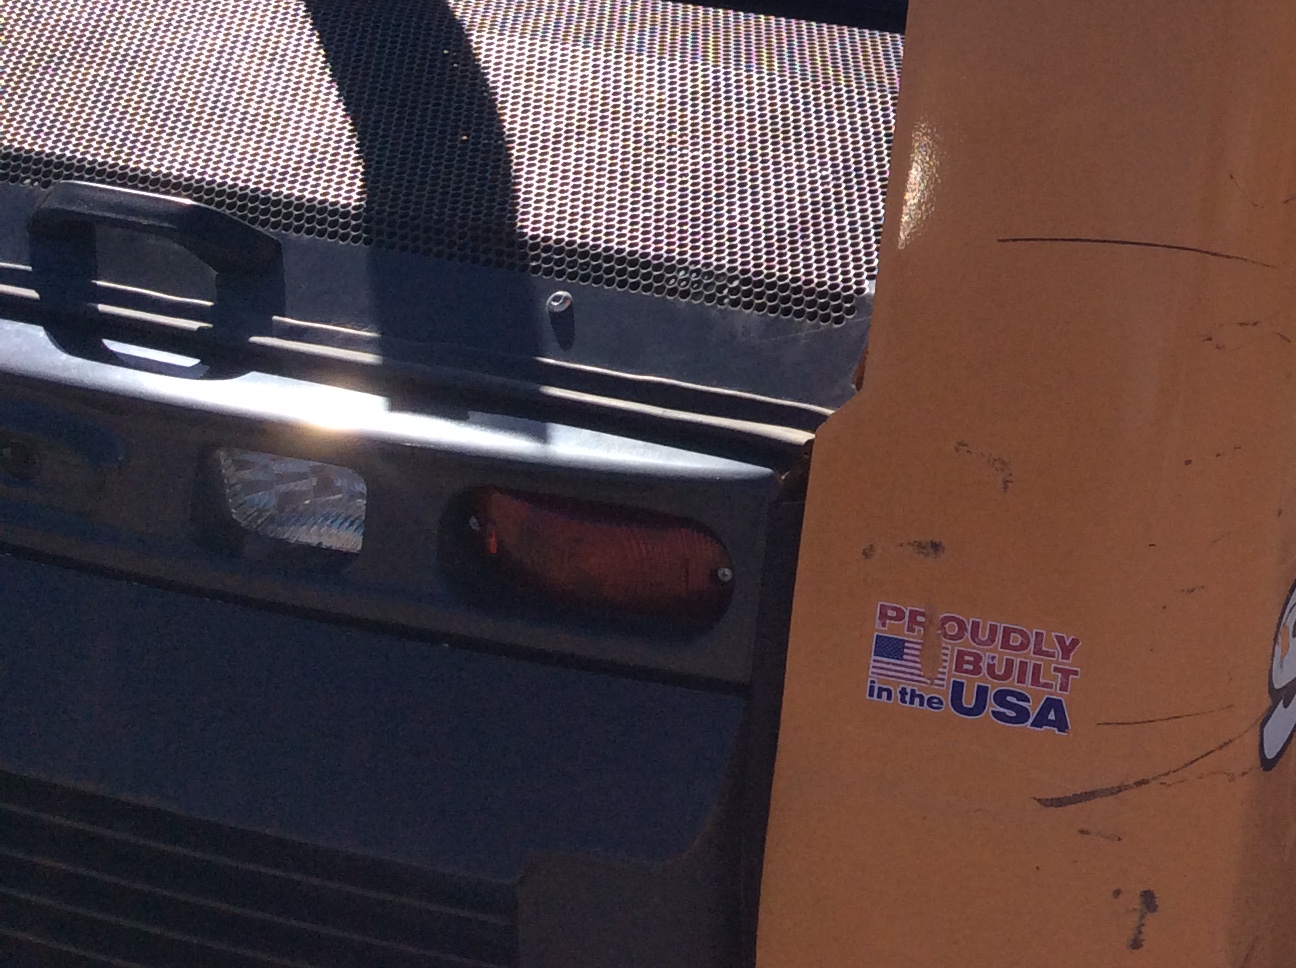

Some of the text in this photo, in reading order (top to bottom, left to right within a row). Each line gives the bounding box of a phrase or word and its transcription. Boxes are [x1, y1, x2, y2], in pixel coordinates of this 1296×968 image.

[952, 647, 1080, 693] BUILT
[867, 679, 1070, 734] in the USA
